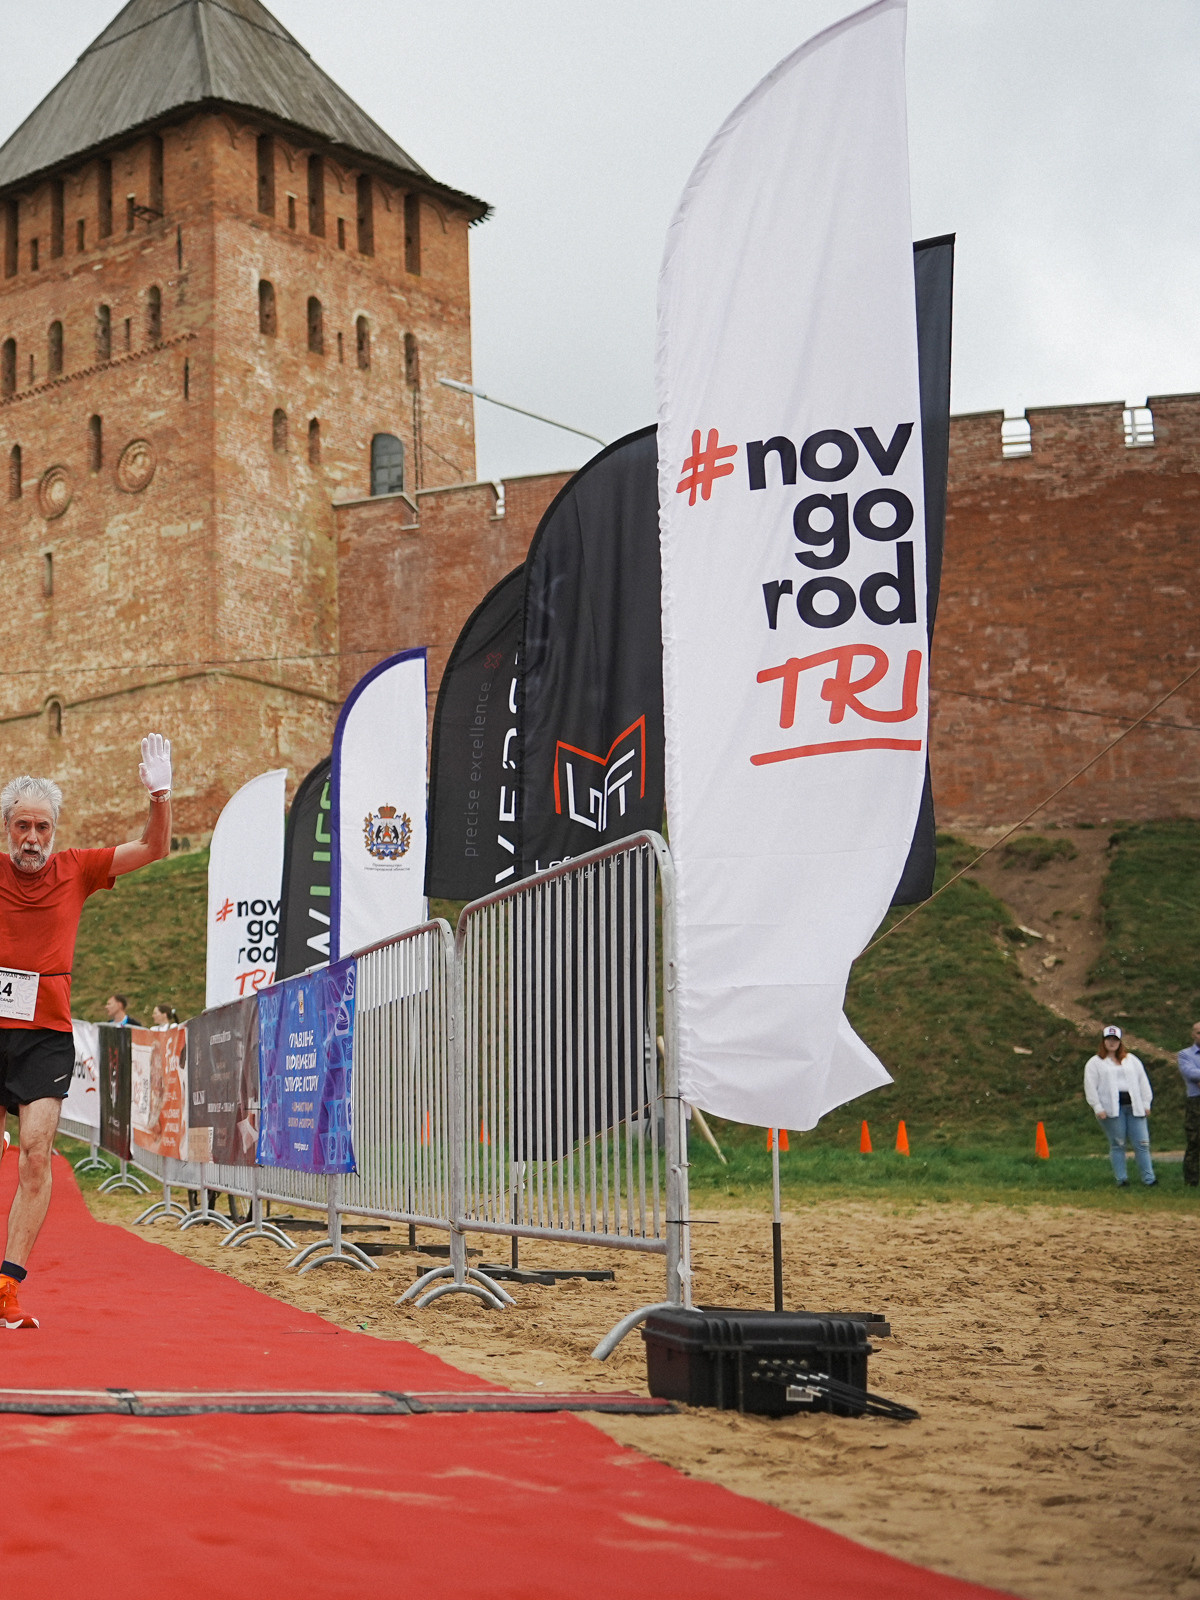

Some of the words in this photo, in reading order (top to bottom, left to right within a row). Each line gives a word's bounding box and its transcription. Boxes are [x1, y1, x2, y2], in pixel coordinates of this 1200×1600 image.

[676, 422, 915, 507] #nov
[793, 488, 914, 570] go
[762, 541, 917, 630] rod
[756, 643, 922, 729] TRI
[469, 681, 491, 782] excellence
[464, 788, 480, 857] precise
[237, 937, 278, 964] rod
[247, 919, 279, 944] go
